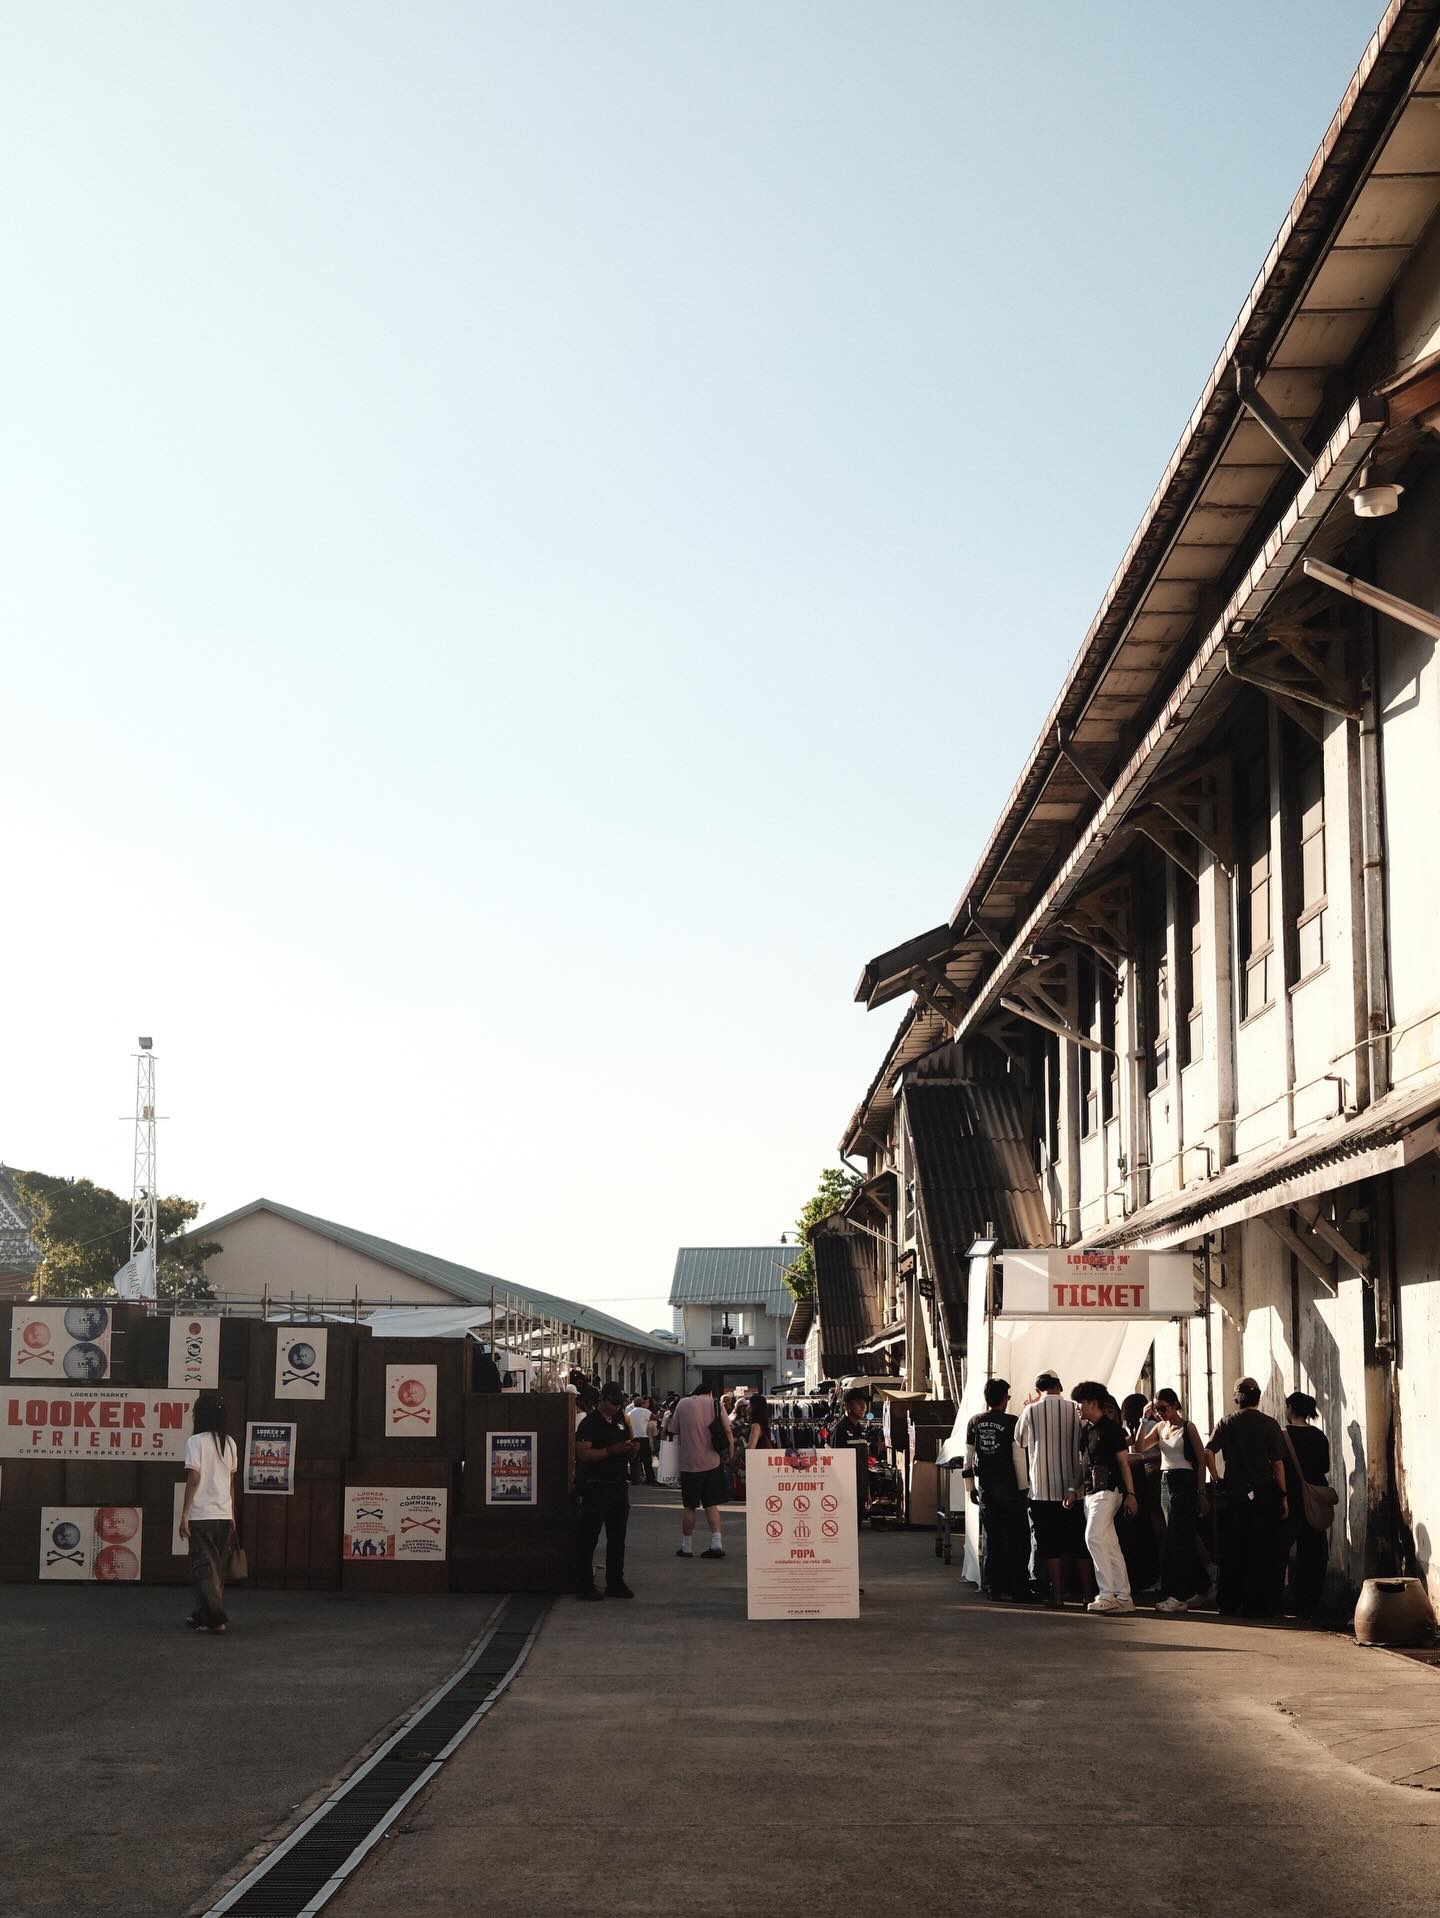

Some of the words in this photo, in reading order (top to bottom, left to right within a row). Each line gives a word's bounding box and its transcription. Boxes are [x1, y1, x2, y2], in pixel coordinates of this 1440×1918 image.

[1067, 1255, 1115, 1265] LOOKER
[1053, 1284, 1145, 1307] TICKET
[8, 1399, 146, 1428] LOOKER
[32, 1430, 164, 1448] FRIENDS
[768, 1455, 818, 1466] LOOKER
[778, 1481, 825, 1491] DO/DON'T
[790, 1549, 816, 1558] POPA
